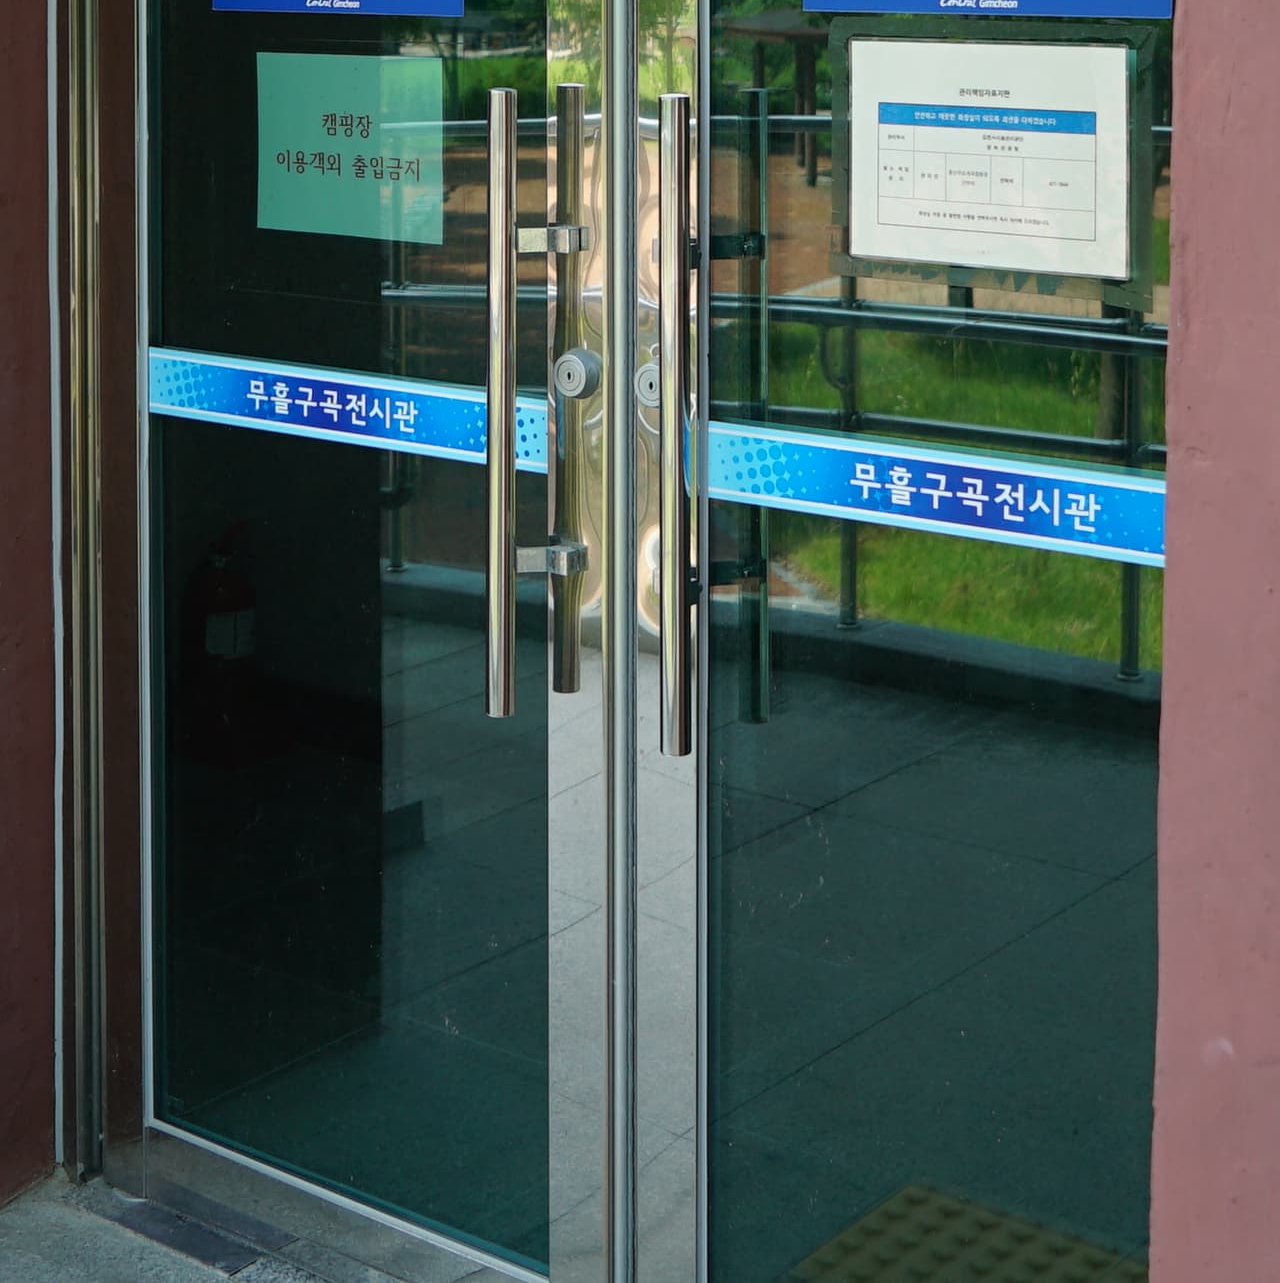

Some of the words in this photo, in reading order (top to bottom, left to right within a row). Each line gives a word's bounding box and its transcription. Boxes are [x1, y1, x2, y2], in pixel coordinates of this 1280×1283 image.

[322, 112, 373, 139] 캠핑장
[276, 149, 342, 177] 이용객외
[351, 154, 422, 183] 출입금지
[246, 379, 419, 434] 무흘구곡전시관
[849, 462, 1102, 533] 무흘구곡전시관
